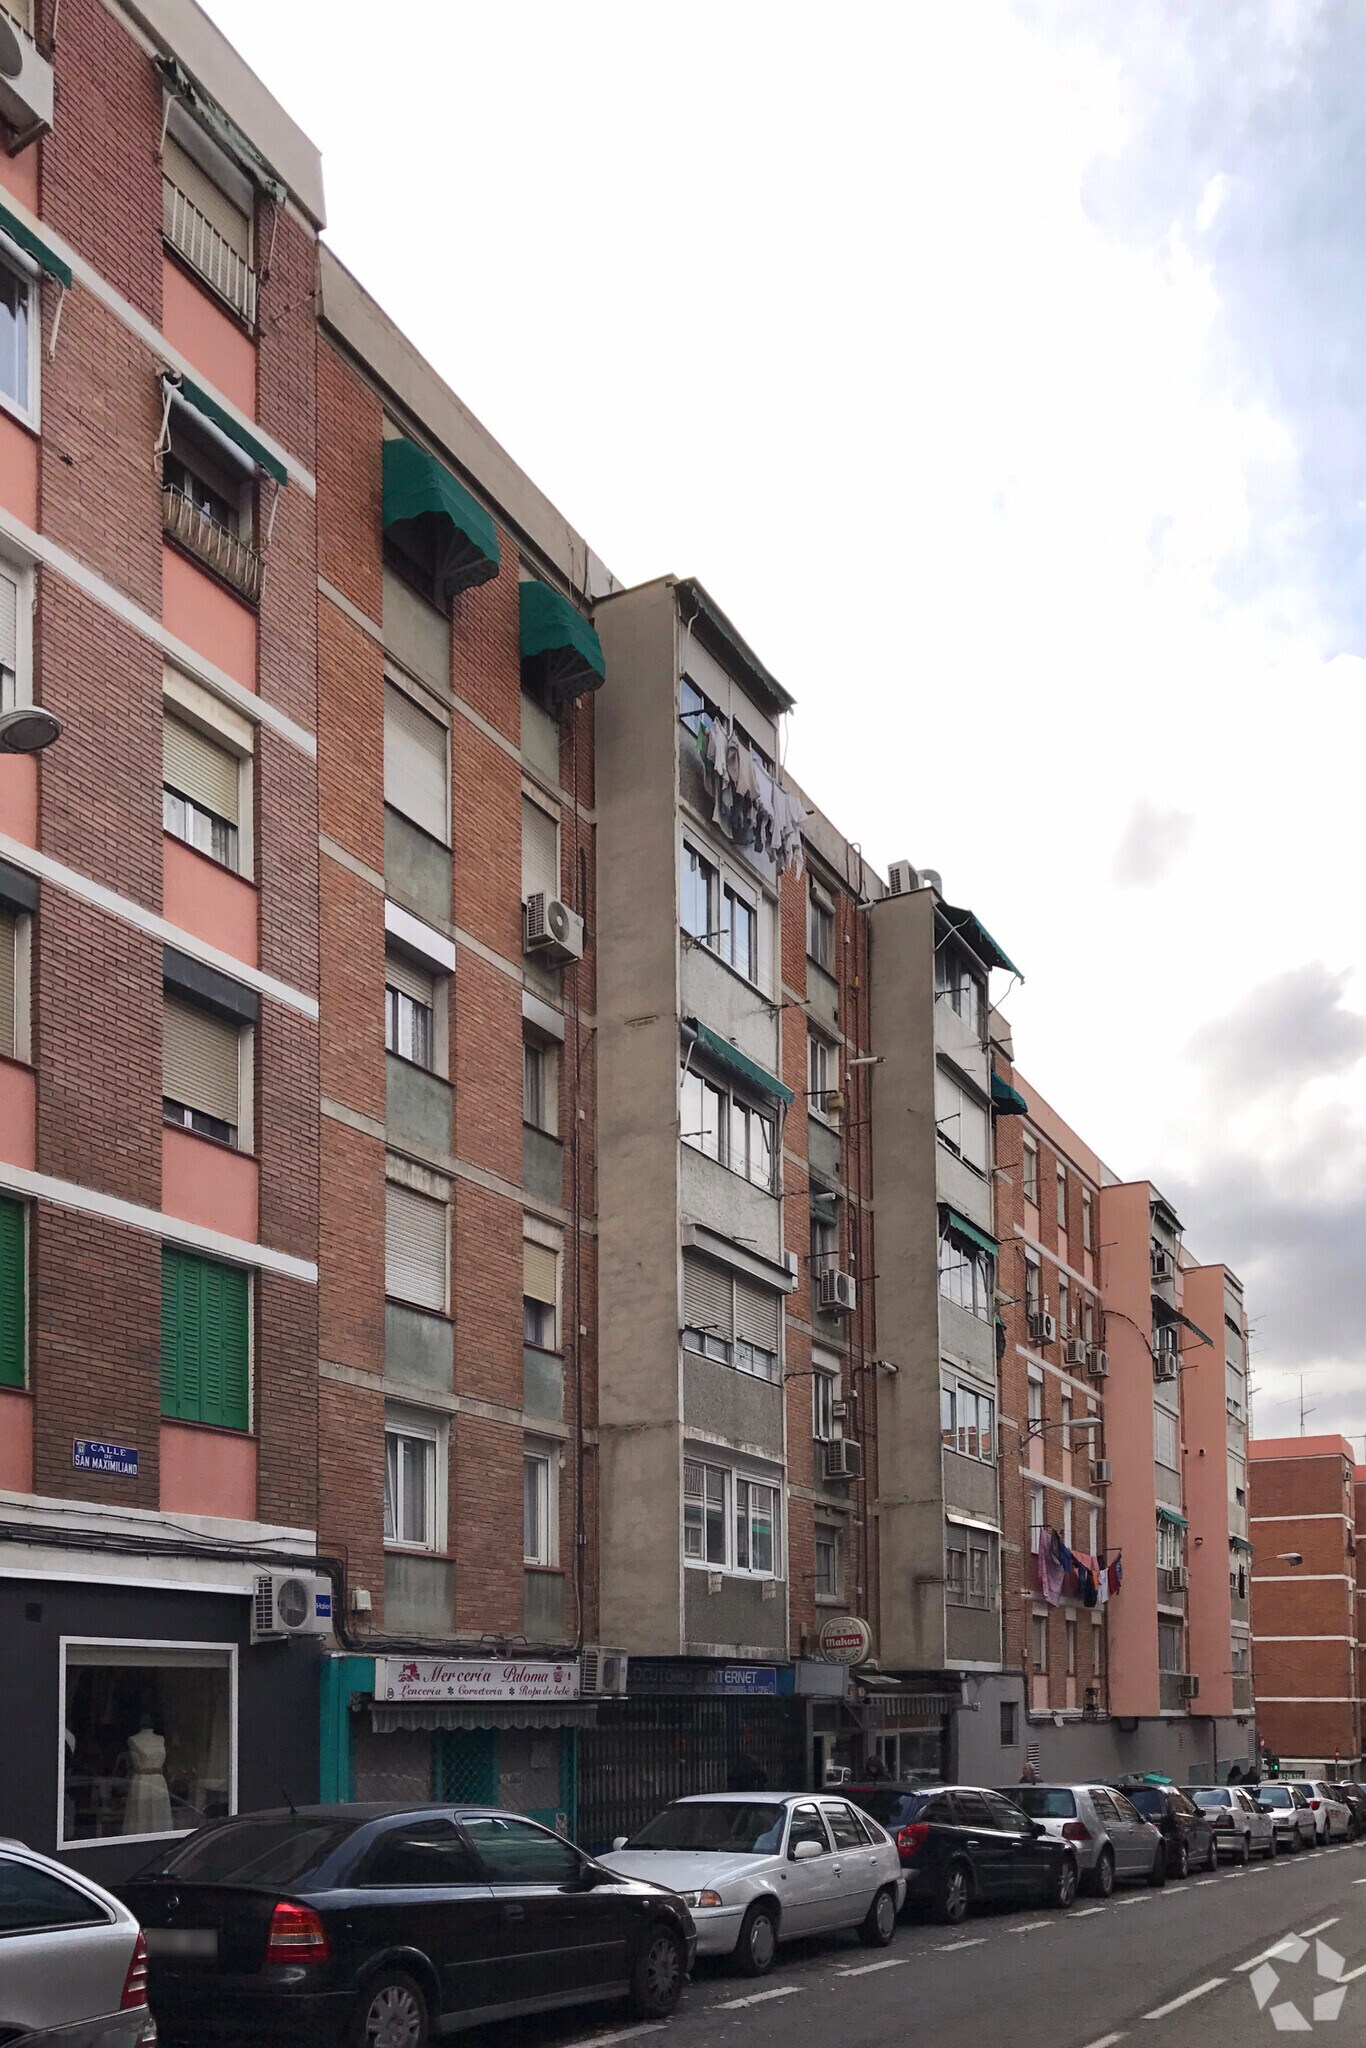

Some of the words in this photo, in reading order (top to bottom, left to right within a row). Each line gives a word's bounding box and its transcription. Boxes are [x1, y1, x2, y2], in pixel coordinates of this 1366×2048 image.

[90, 1443, 127, 1457] CALLE
[75, 1454, 90, 1467] SAN
[92, 1456, 138, 1475] MAXIMILIANO
[825, 1637, 861, 1648] Mahou
[422, 1664, 491, 1683] Mercería
[500, 1665, 549, 1683] Paloma
[707, 1669, 758, 1685] INTERNET
[518, 1684, 542, 1699] Ropa
[542, 1685, 553, 1696] de
